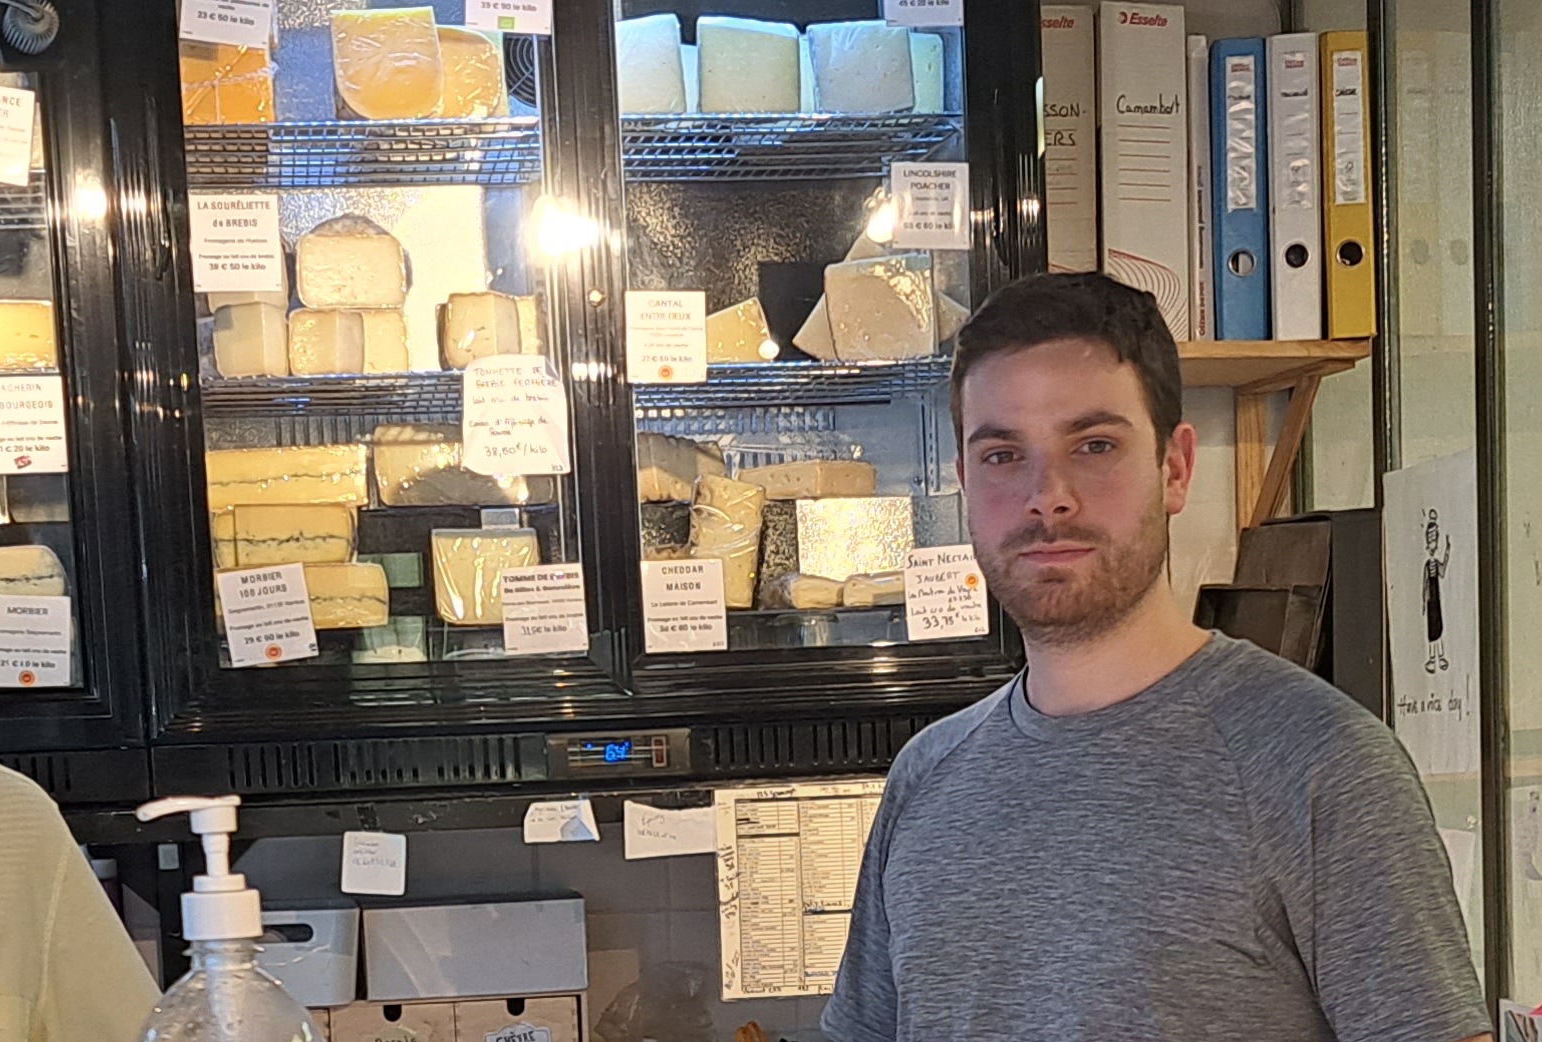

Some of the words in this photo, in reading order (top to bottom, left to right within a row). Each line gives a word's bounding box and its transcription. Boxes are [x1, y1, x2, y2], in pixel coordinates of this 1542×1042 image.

[1040, 16, 1074, 30] sselte
[1129, 13, 1168, 28] Esselte
[902, 170, 957, 179] LINCOLSHIRE
[910, 182, 951, 191] POACHER
[197, 201, 209, 210] LA
[225, 219, 258, 228] BREBIS
[648, 299, 684, 308] CANTAL
[640, 312, 667, 321] ENTRE
[669, 312, 692, 321] DEUX
[937, 550, 976, 566] NECTAI
[661, 565, 705, 575] CHEDDAR
[240, 571, 284, 585] MORBIER
[503, 573, 533, 584] TOMME
[535, 573, 548, 582] DE
[666, 581, 702, 591] MAISON
[6, 606, 49, 616] MORBIER
